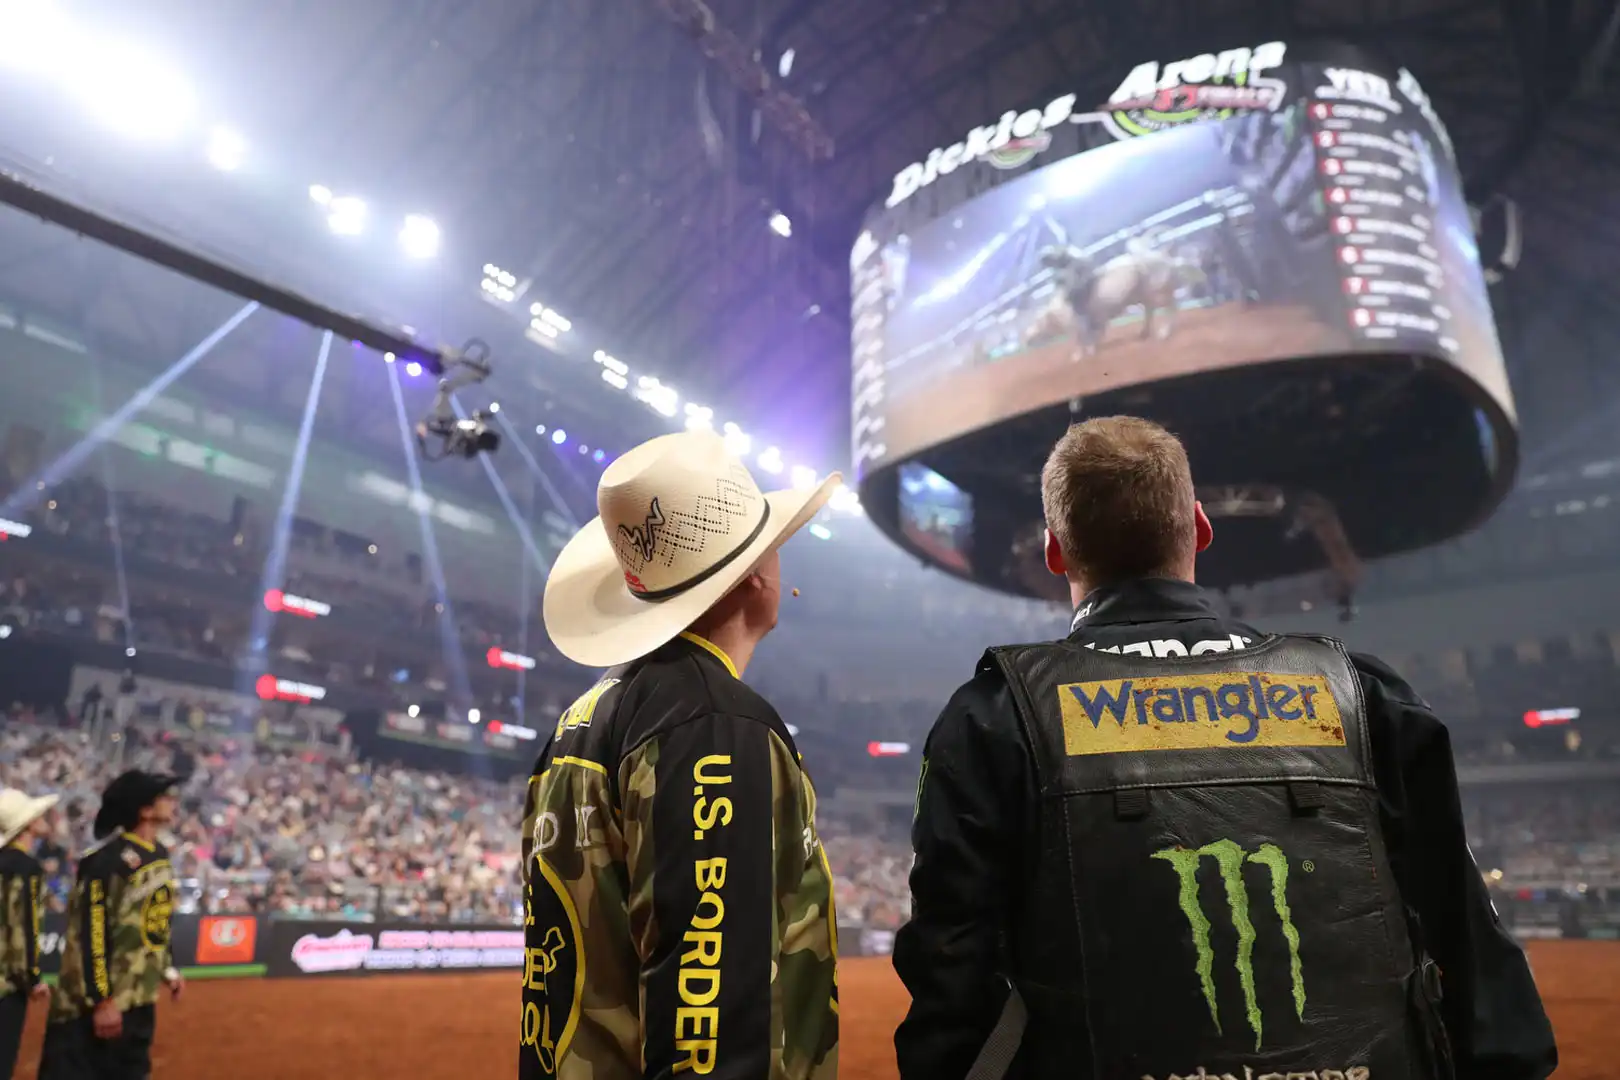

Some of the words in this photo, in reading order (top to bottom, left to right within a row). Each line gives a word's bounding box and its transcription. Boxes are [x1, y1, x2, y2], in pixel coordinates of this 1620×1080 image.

[1069, 674, 1318, 743] Wrangler
[693, 755, 733, 841] U.S.
[671, 857, 727, 1076] BORDER
